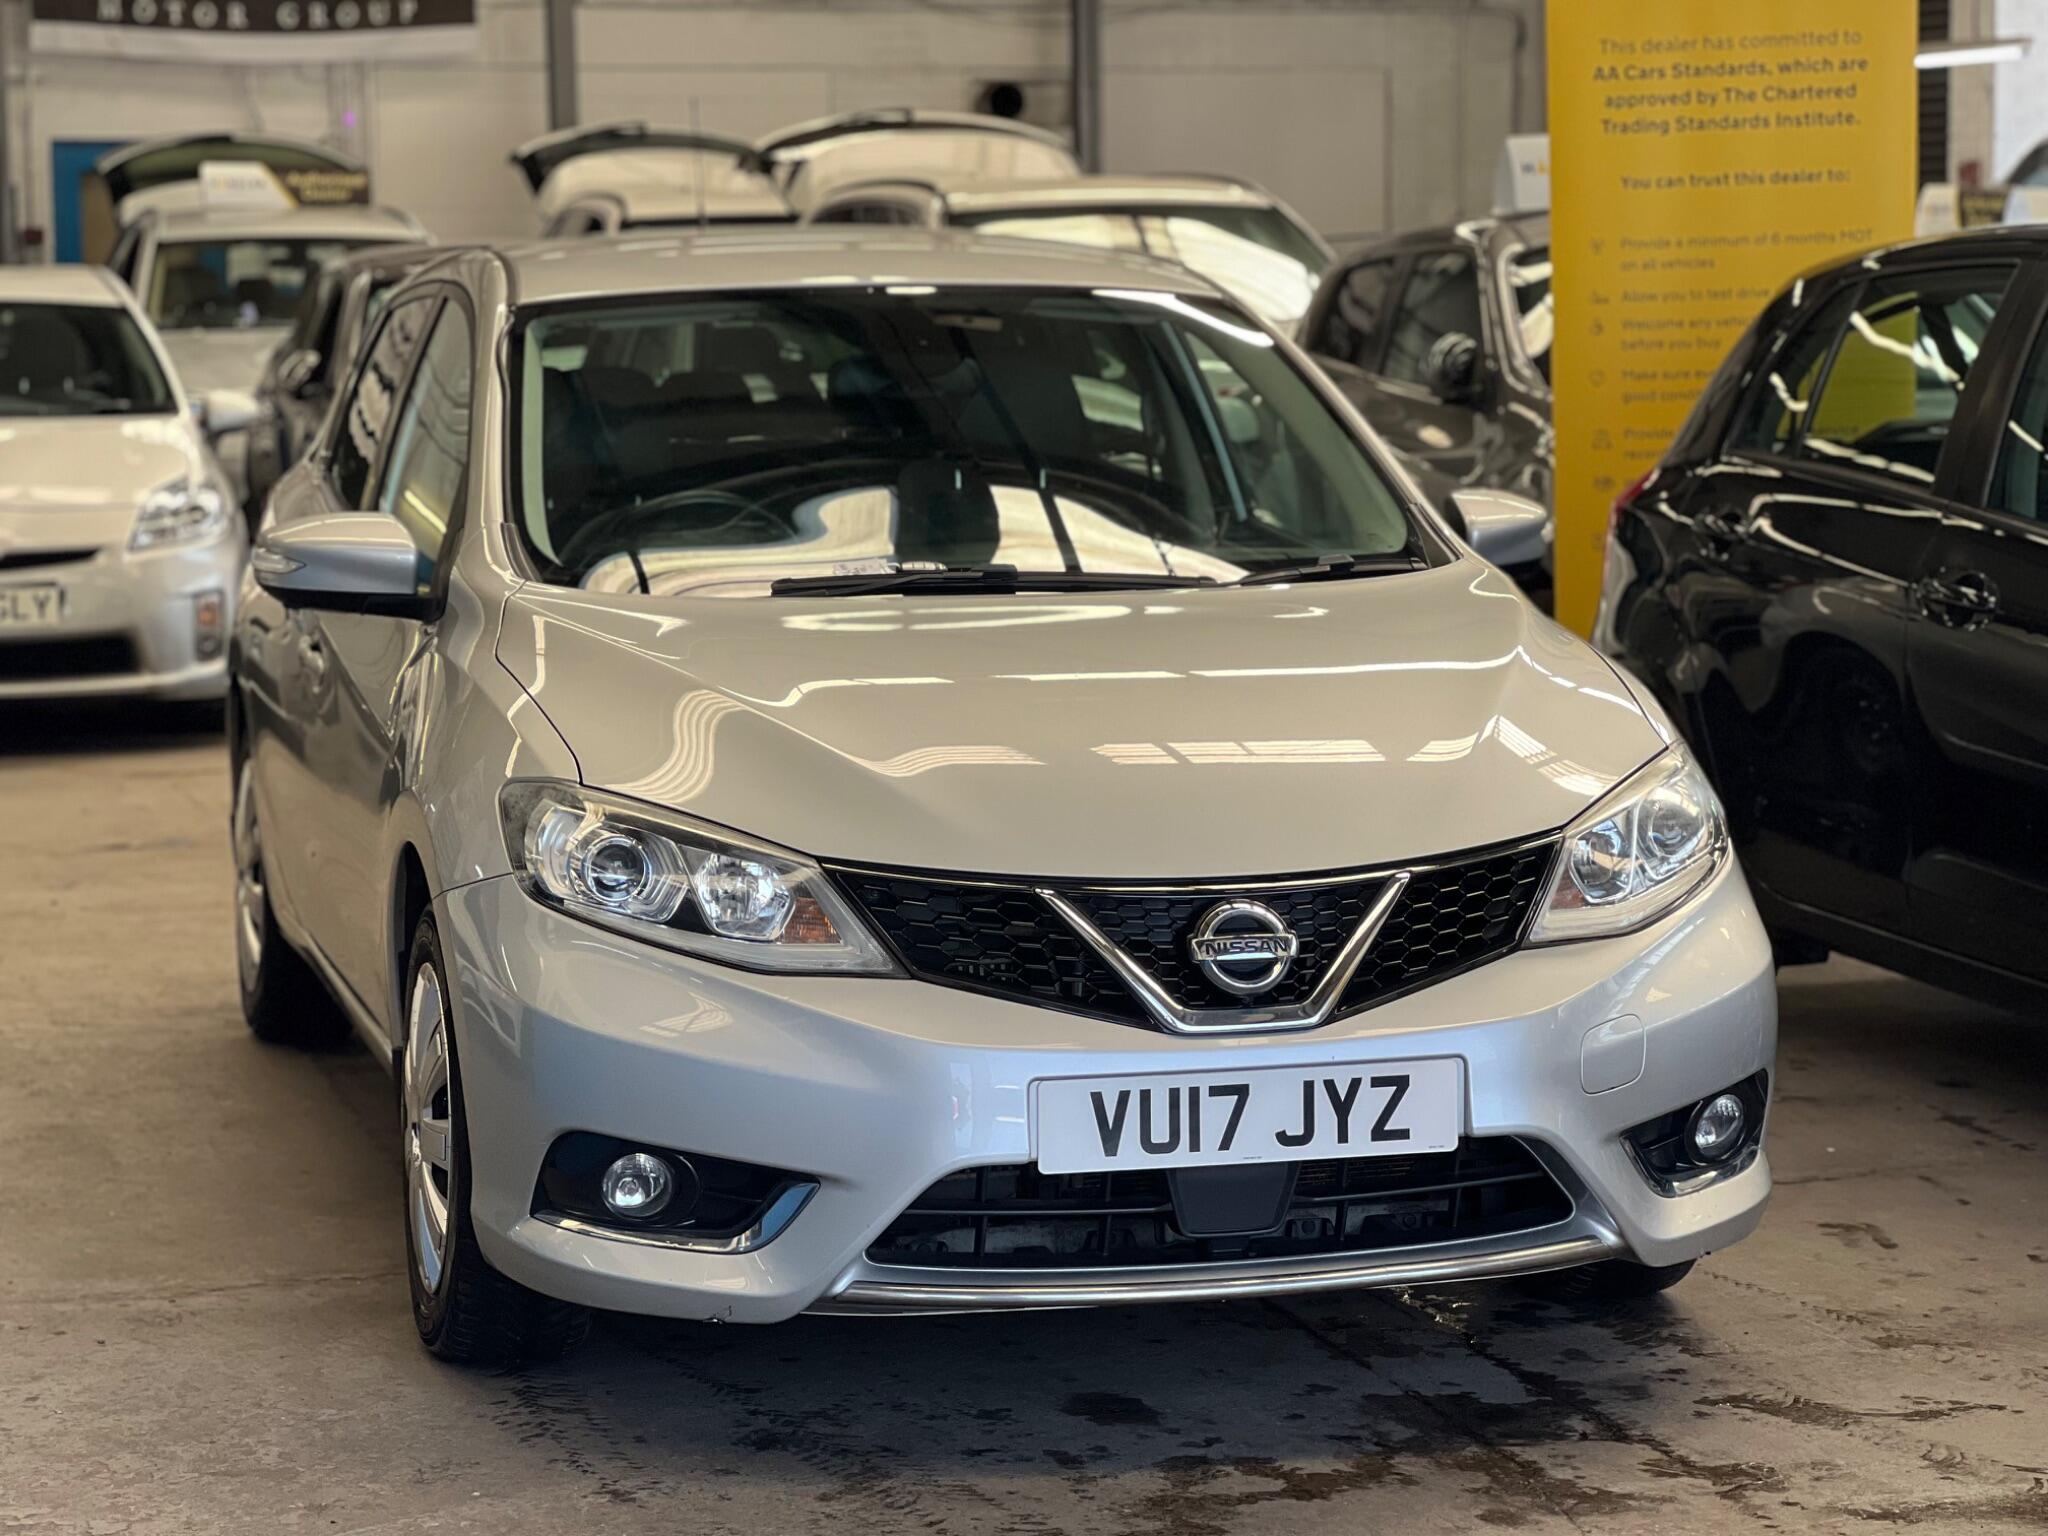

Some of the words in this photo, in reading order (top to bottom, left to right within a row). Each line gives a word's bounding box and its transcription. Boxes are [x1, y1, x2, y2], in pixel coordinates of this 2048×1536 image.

[96, 0, 249, 30] MOTOR
[275, 0, 418, 30] GROUP
[1600, 38, 1635, 54] This
[1642, 36, 1697, 53] dealer
[1703, 35, 1734, 51] has
[1740, 31, 1838, 50] committed
[1844, 31, 1862, 46] to
[1593, 64, 1619, 80] AA
[1624, 64, 1666, 79] Cars
[1672, 60, 1772, 78] Standards,
[1777, 58, 1833, 73] which
[1839, 59, 1868, 72] are
[1605, 90, 1691, 109] approved
[1696, 89, 1717, 107] by
[1724, 86, 1757, 103] The
[1763, 82, 1856, 102] Chartered
[1602, 117, 1670, 136] Trading
[1675, 114, 1770, 132] Standards
[1776, 110, 1861, 128] Institute.
[1621, 175, 1651, 190] You
[1655, 175, 1685, 189] can
[1689, 172, 1729, 188] trust
[1734, 170, 1765, 186] this
[1769, 168, 1822, 184] dealer
[1620, 236, 1671, 249] Provide
[1687, 235, 1750, 249] minimum
[1754, 233, 1768, 245] of
[1784, 231, 1836, 244] months
[1661, 257, 1715, 270] vehicles
[1205, 938, 1288, 956] NISSAN
[1090, 1083, 1250, 1158] VU17
[1275, 1074, 1410, 1148] JYZ
